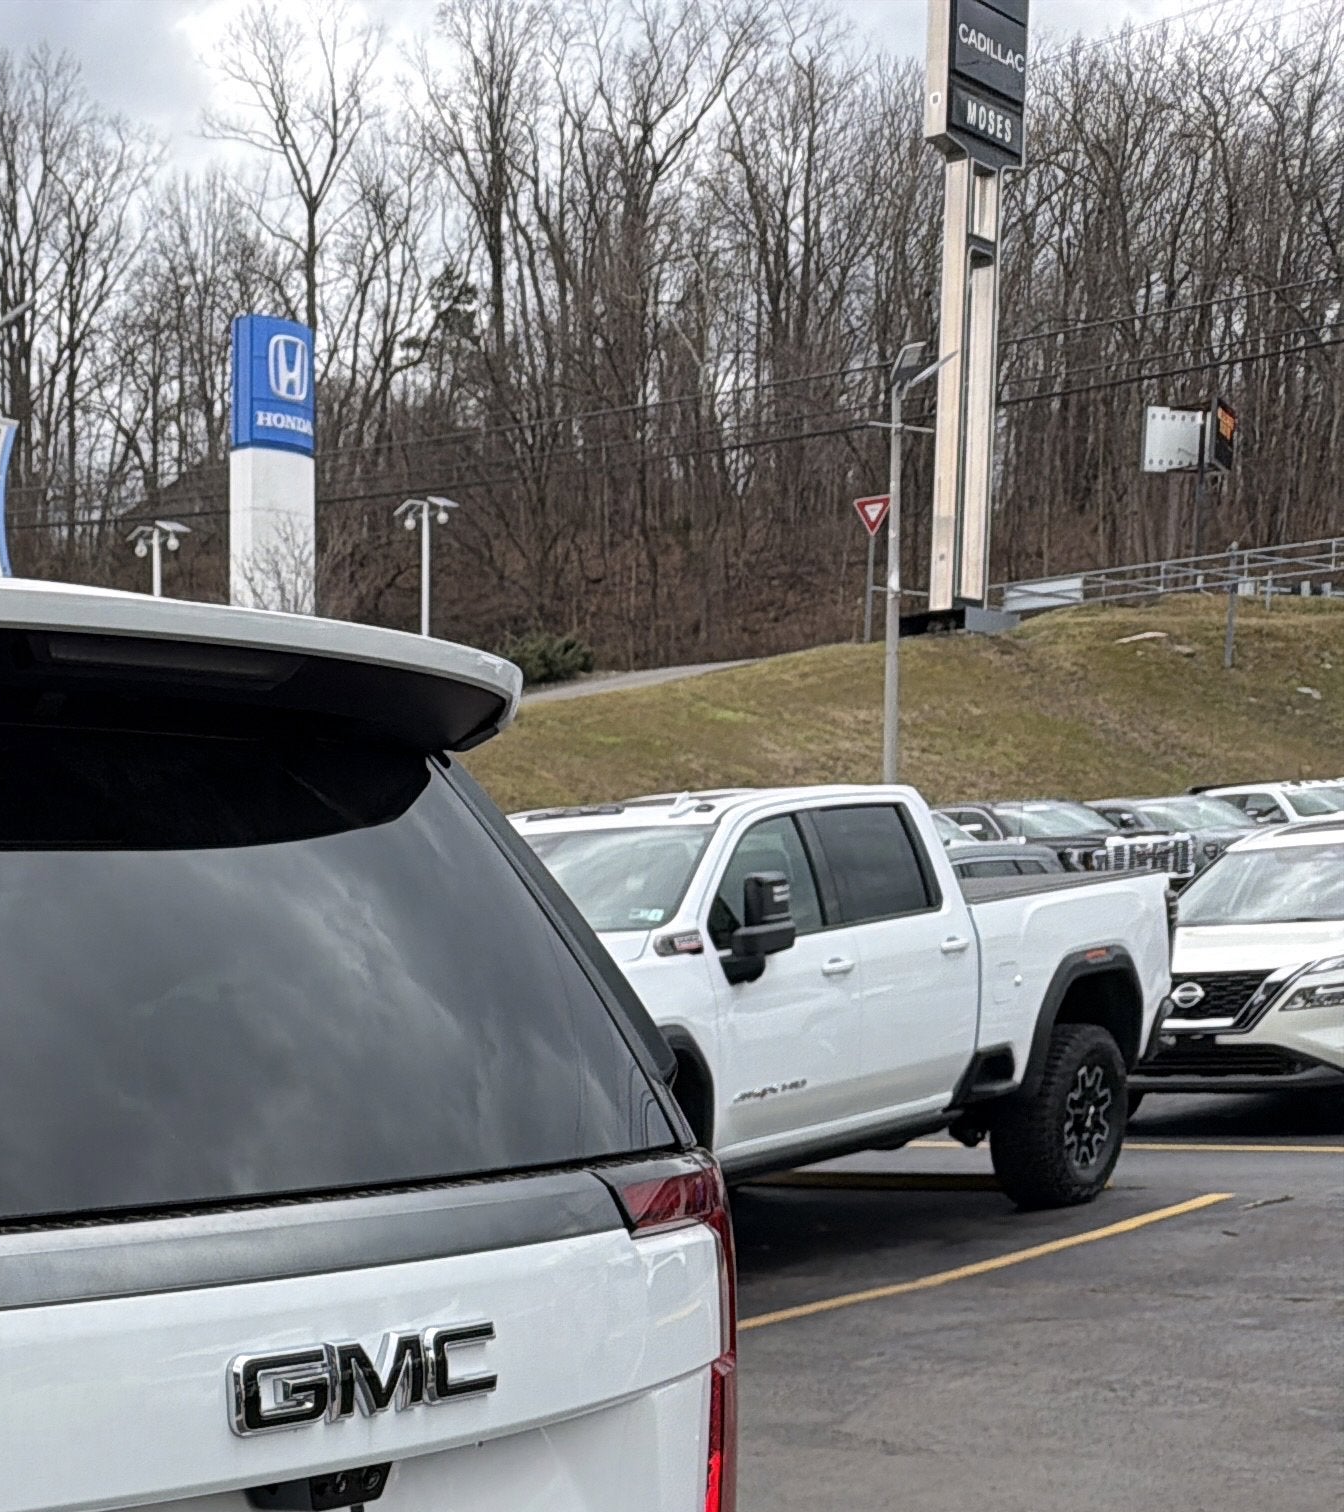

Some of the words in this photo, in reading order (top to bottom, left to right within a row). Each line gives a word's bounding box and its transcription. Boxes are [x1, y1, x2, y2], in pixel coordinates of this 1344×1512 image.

[958, 23, 1025, 73] CADILLAC
[967, 100, 1012, 143] MOSES
[255, 410, 314, 437] HONDA
[226, 1320, 498, 1438] GMC
